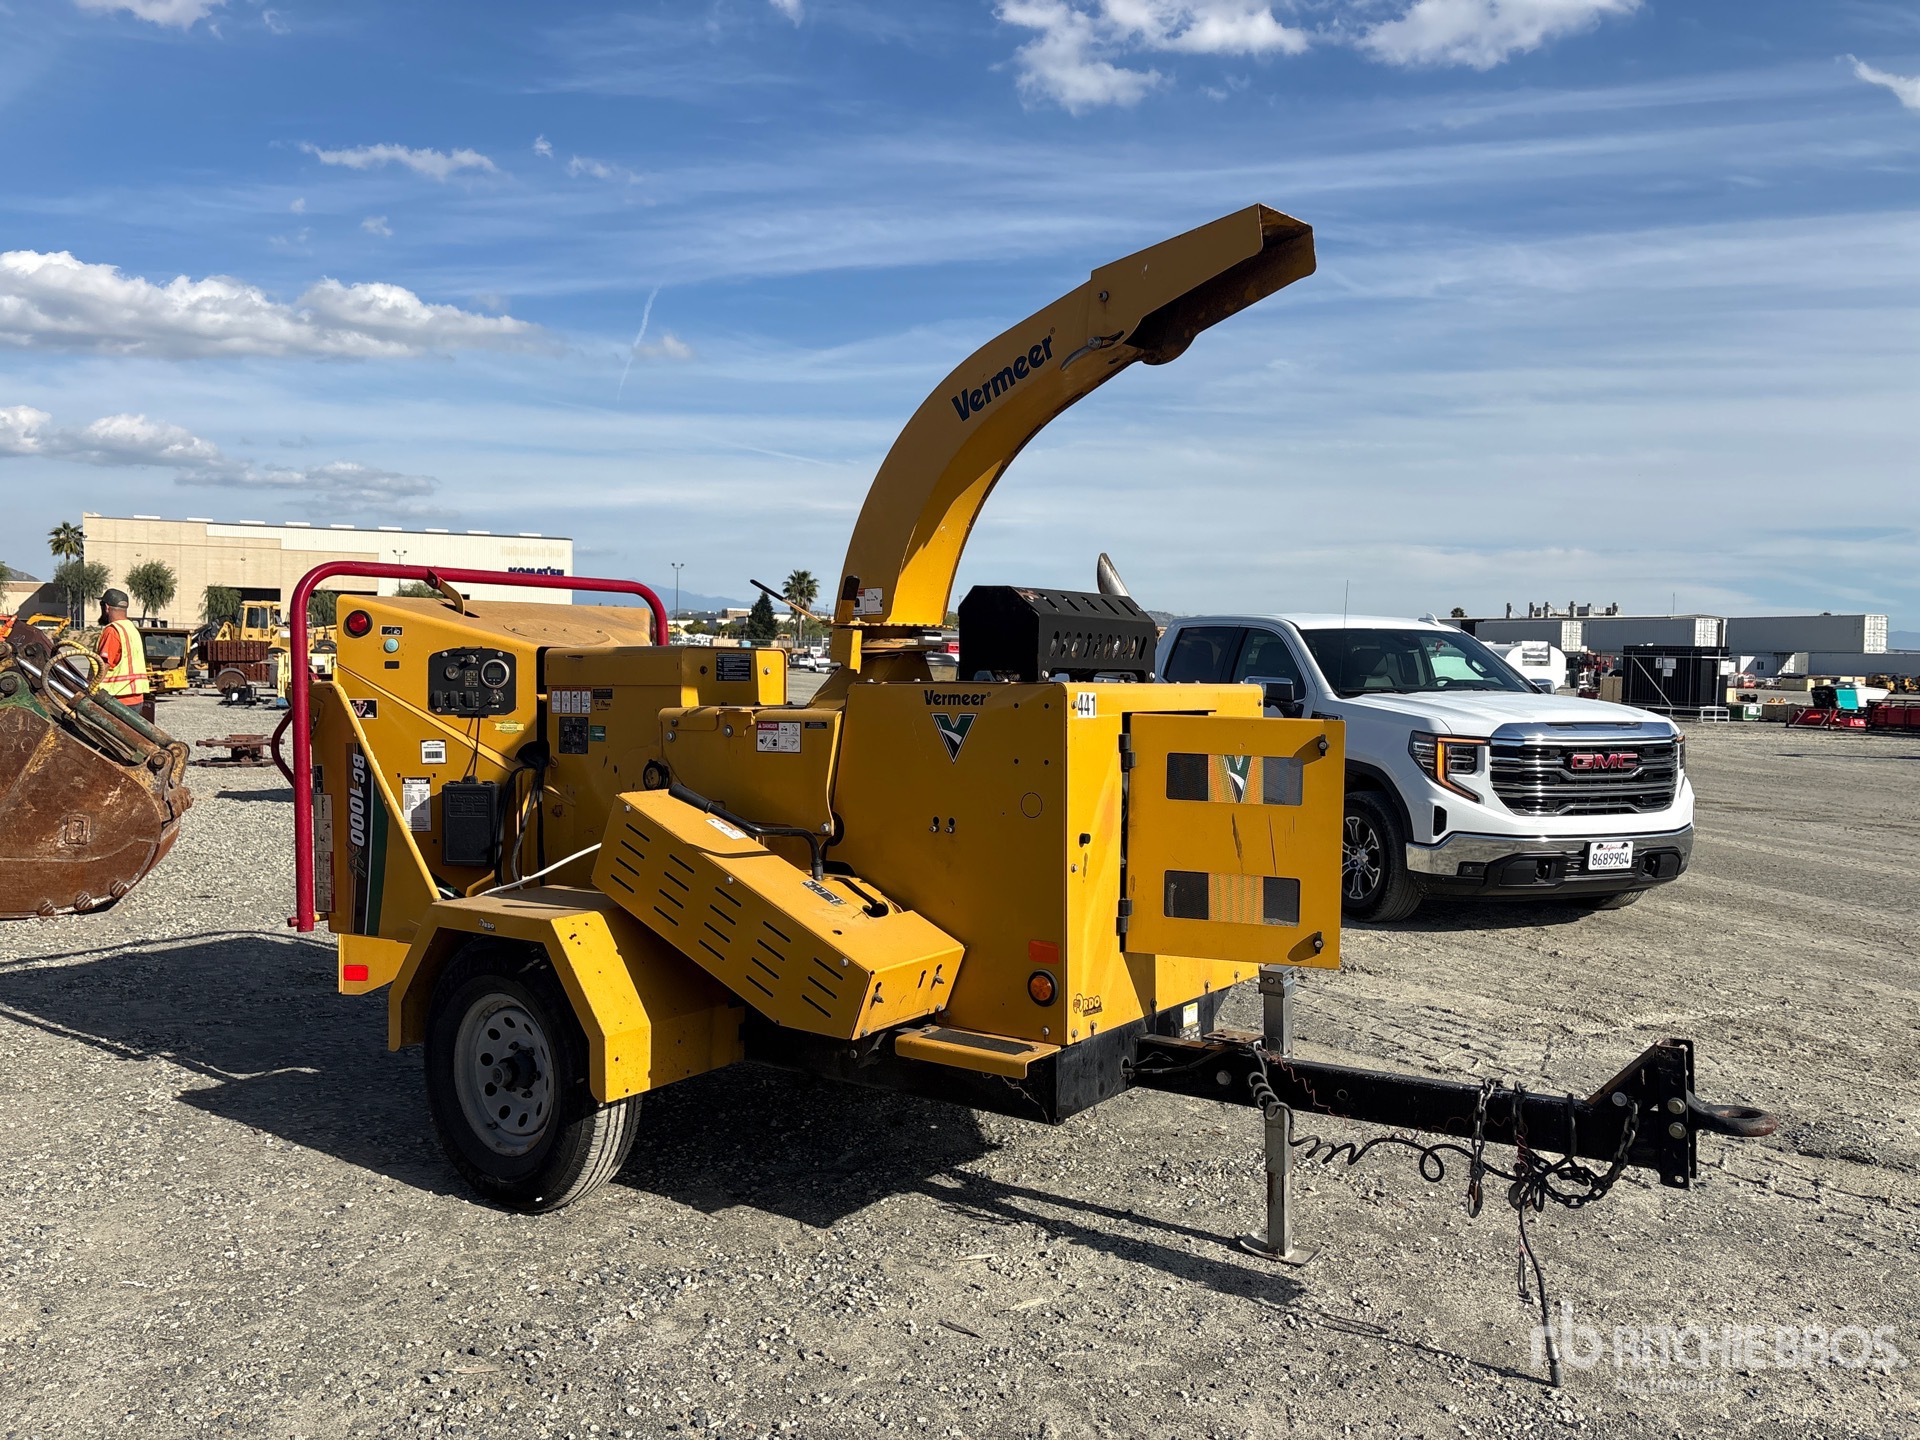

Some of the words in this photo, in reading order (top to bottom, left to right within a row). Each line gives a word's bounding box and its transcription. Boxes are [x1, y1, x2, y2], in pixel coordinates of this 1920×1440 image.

[951, 335, 1053, 421] Vermeer
[924, 690, 986, 706] Vermeer
[1077, 694, 1097, 717] 441
[1571, 753, 1638, 770] GMC
[1592, 852, 1629, 866] 86899G4
